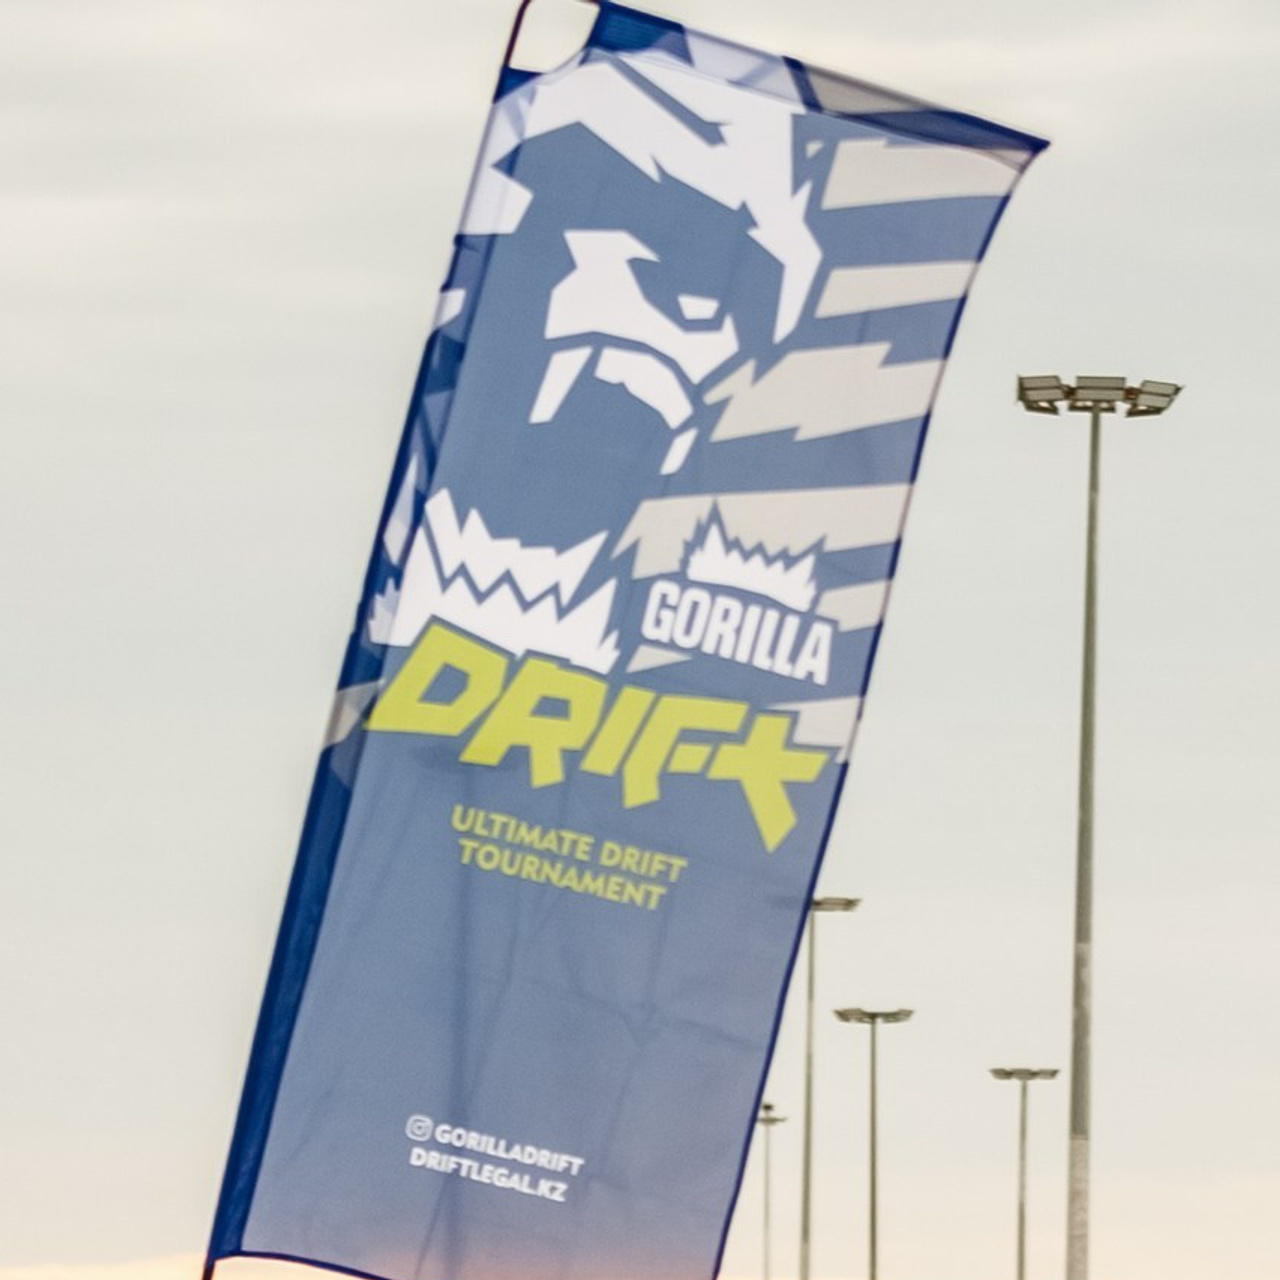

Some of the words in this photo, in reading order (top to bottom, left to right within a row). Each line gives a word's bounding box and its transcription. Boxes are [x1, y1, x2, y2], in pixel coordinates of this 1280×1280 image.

[641, 579, 833, 686] GORILLA
[451, 803, 595, 862] ULTIMATE
[600, 841, 688, 884] DRIFT
[459, 837, 668, 911] TOURNAMENT
[434, 1123, 585, 1176] GORILLADRIFT
